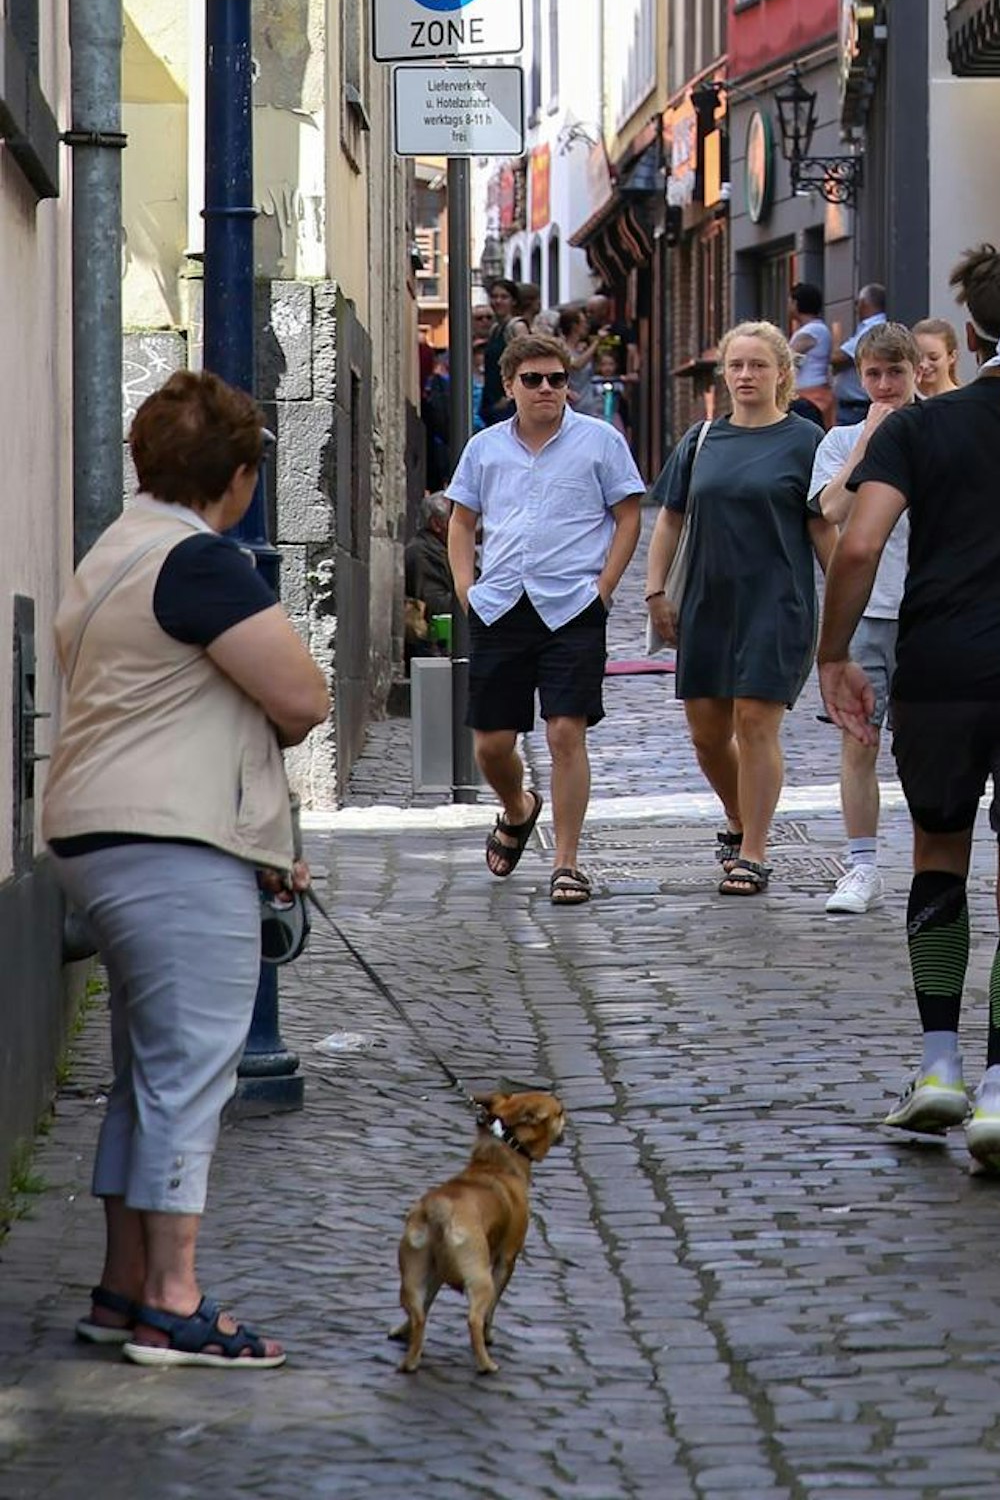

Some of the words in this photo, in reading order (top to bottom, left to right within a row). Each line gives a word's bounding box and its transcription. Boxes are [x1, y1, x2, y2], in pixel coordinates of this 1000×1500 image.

[410, 18, 485, 49] ZONE
[427, 79, 487, 93] Lieferverkehr
[436, 97, 491, 110] Hotelzufahrt
[423, 114, 463, 128] werktags
[465, 113, 484, 125] 8-11
[485, 114, 493, 125] h
[451, 130, 468, 142] frei
